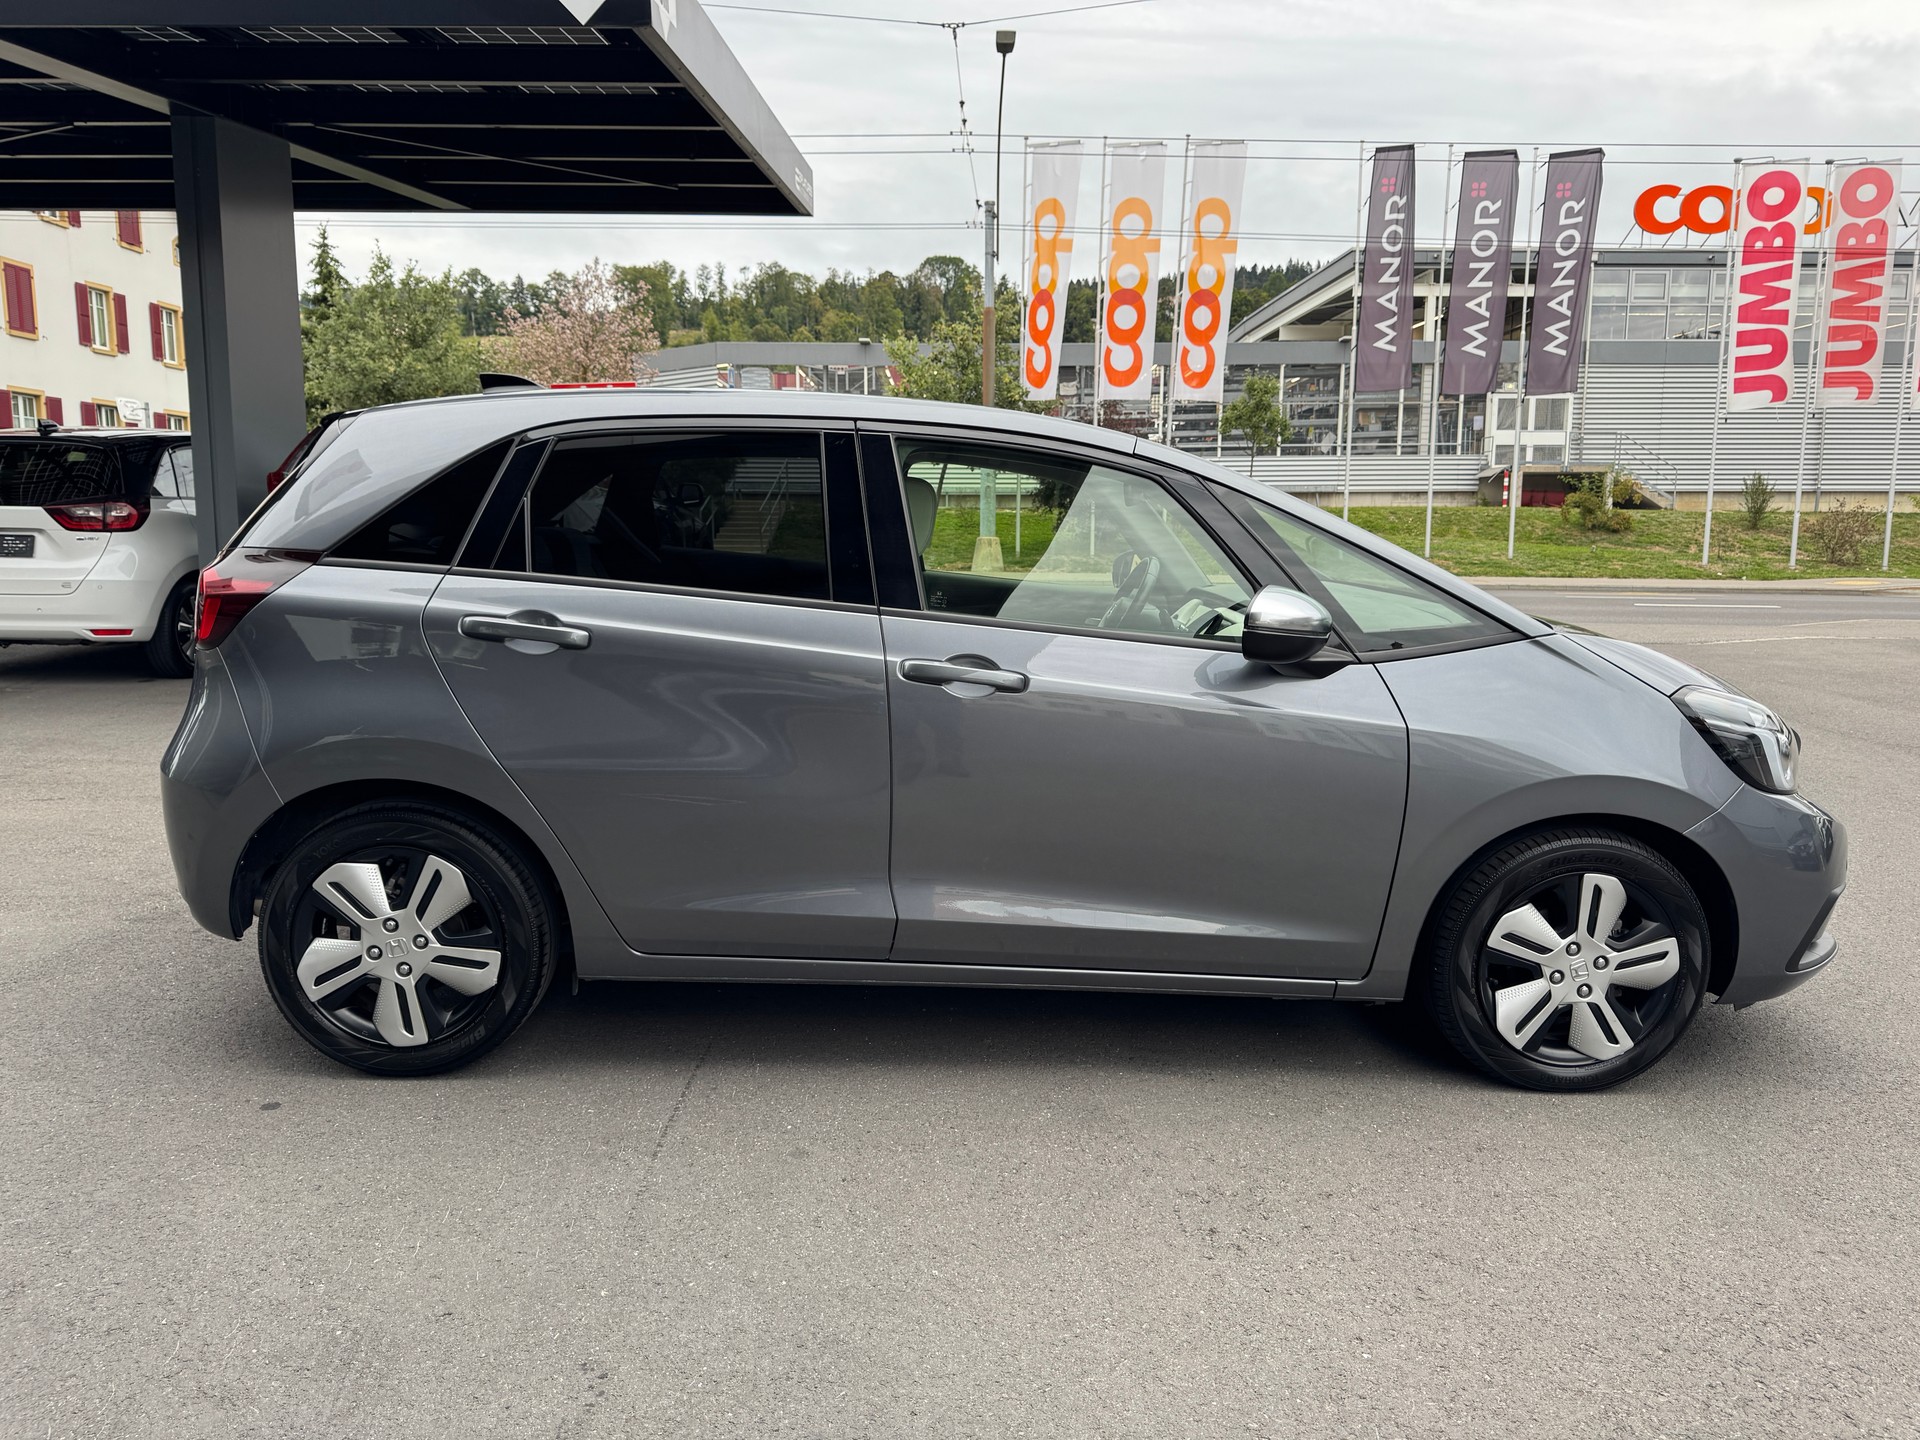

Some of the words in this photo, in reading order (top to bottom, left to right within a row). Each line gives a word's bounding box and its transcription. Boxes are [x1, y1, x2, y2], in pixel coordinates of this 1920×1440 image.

[1026, 197, 1073, 389] coop
[1104, 197, 1161, 388] coop
[1180, 197, 1238, 389] coop
[1373, 195, 1407, 352] MANOR
[1461, 199, 1502, 357] MANOR
[1543, 197, 1586, 356] MANOR
[1734, 170, 1802, 403] JUMBO
[1823, 167, 1894, 401] JUMBO
